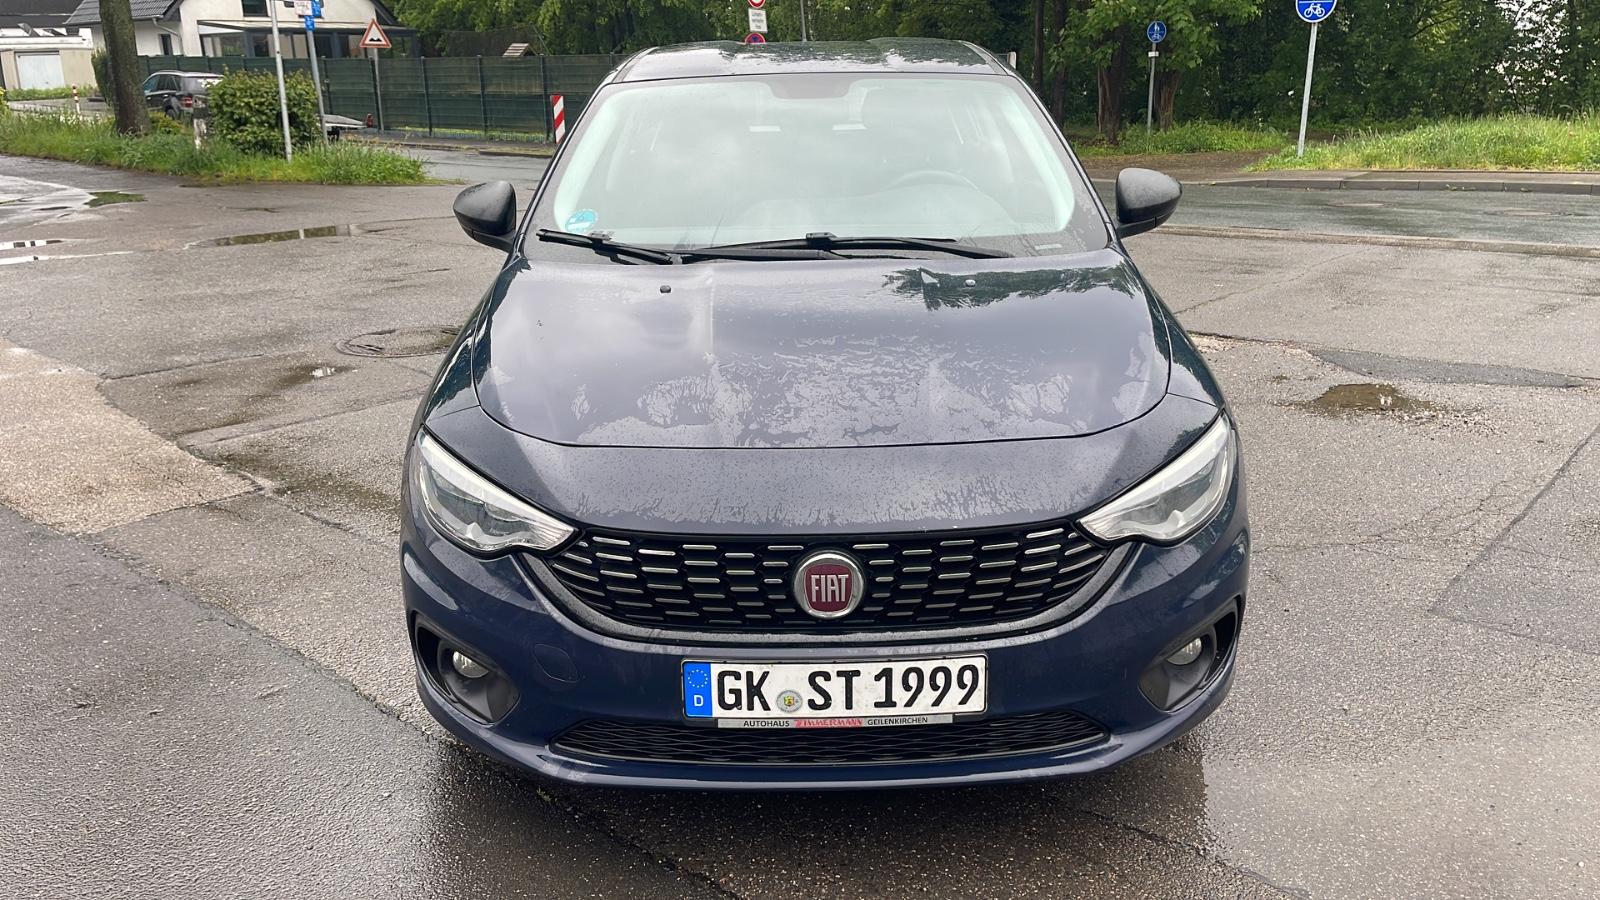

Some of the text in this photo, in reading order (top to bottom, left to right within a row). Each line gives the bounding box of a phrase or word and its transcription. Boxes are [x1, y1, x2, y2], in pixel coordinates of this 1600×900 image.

[811, 574, 849, 602] FIAT
[717, 664, 979, 711] GK ST 1999
[693, 694, 704, 707] D
[794, 718, 863, 728] ZIMMERMANN
[867, 716, 928, 726] GEILENKIRCHEN
